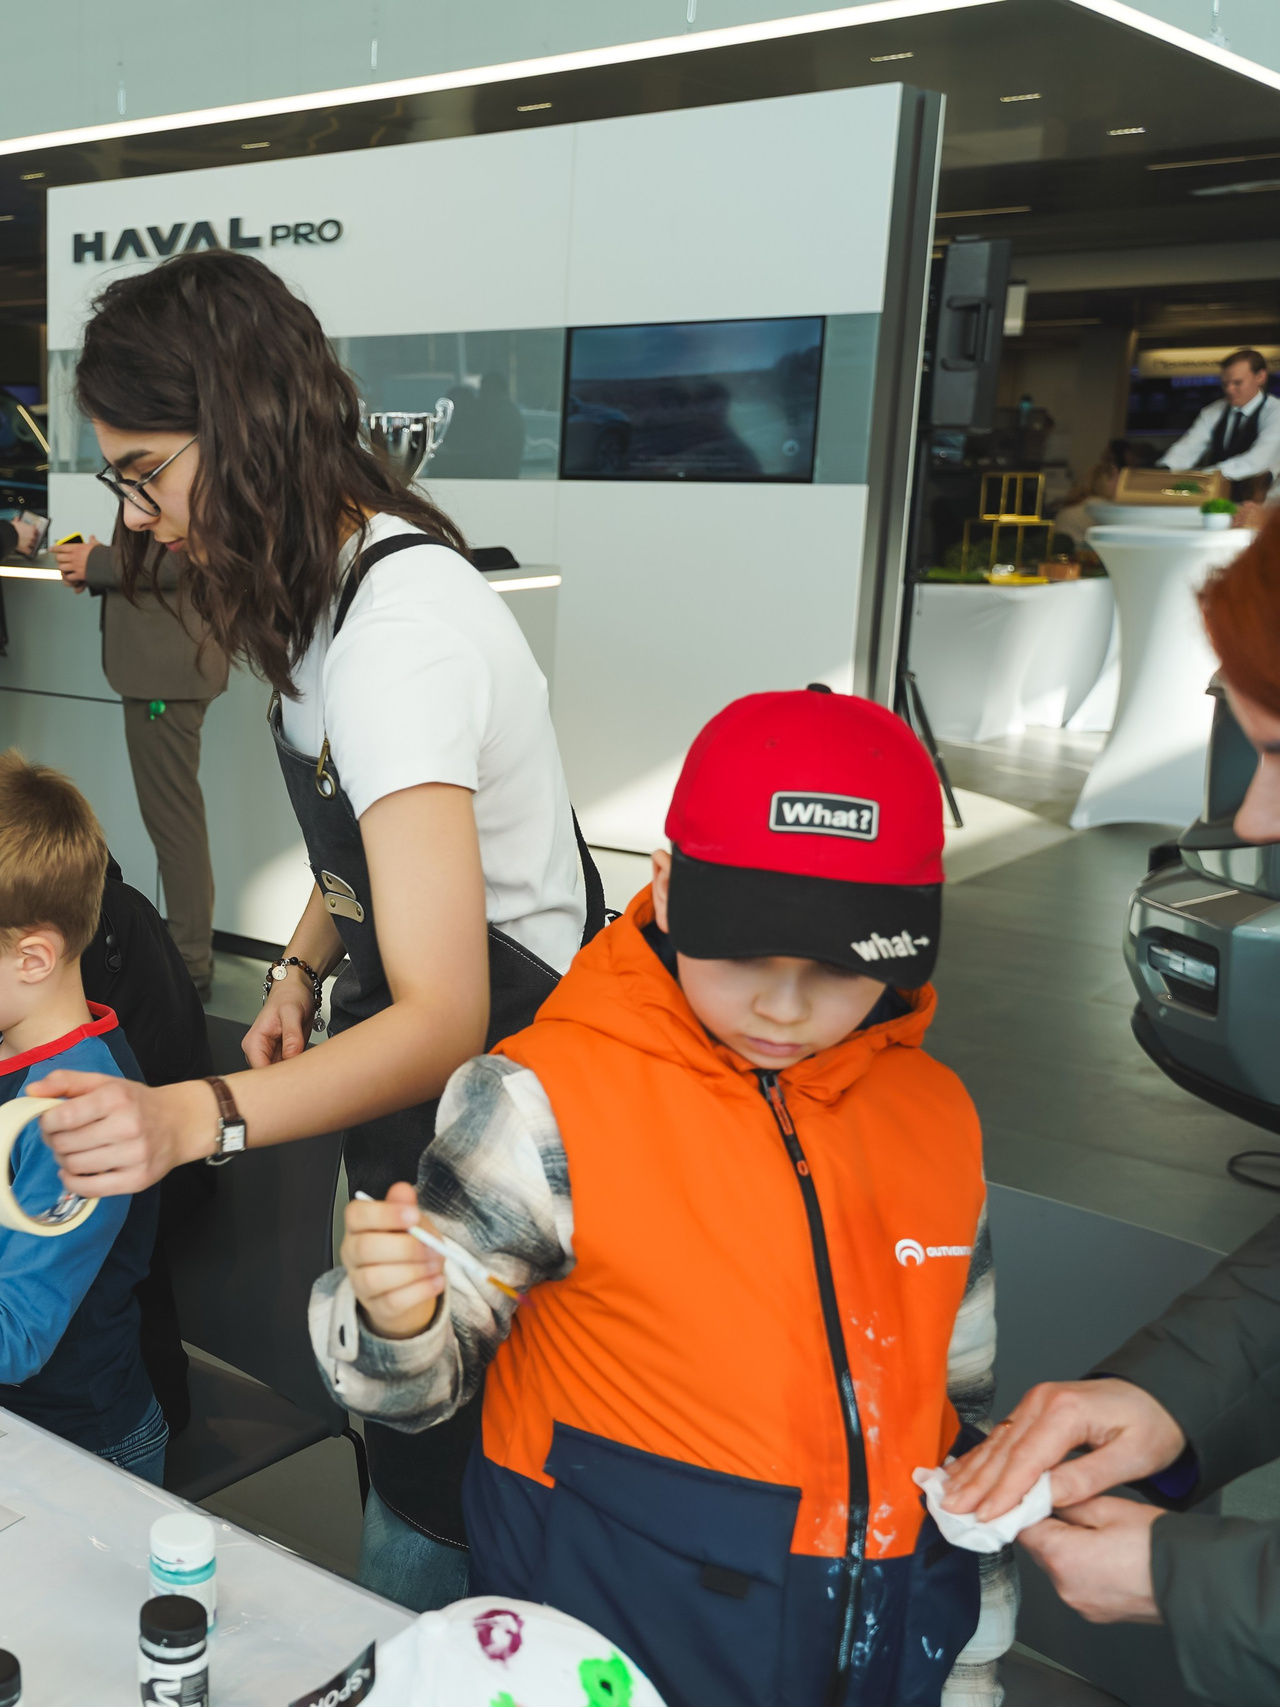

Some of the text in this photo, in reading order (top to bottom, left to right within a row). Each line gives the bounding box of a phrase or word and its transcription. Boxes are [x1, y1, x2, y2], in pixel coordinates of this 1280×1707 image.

[73, 217, 342, 263] HAVAL PRO
[782, 801, 873, 831] What?
[850, 929, 918, 962] what
